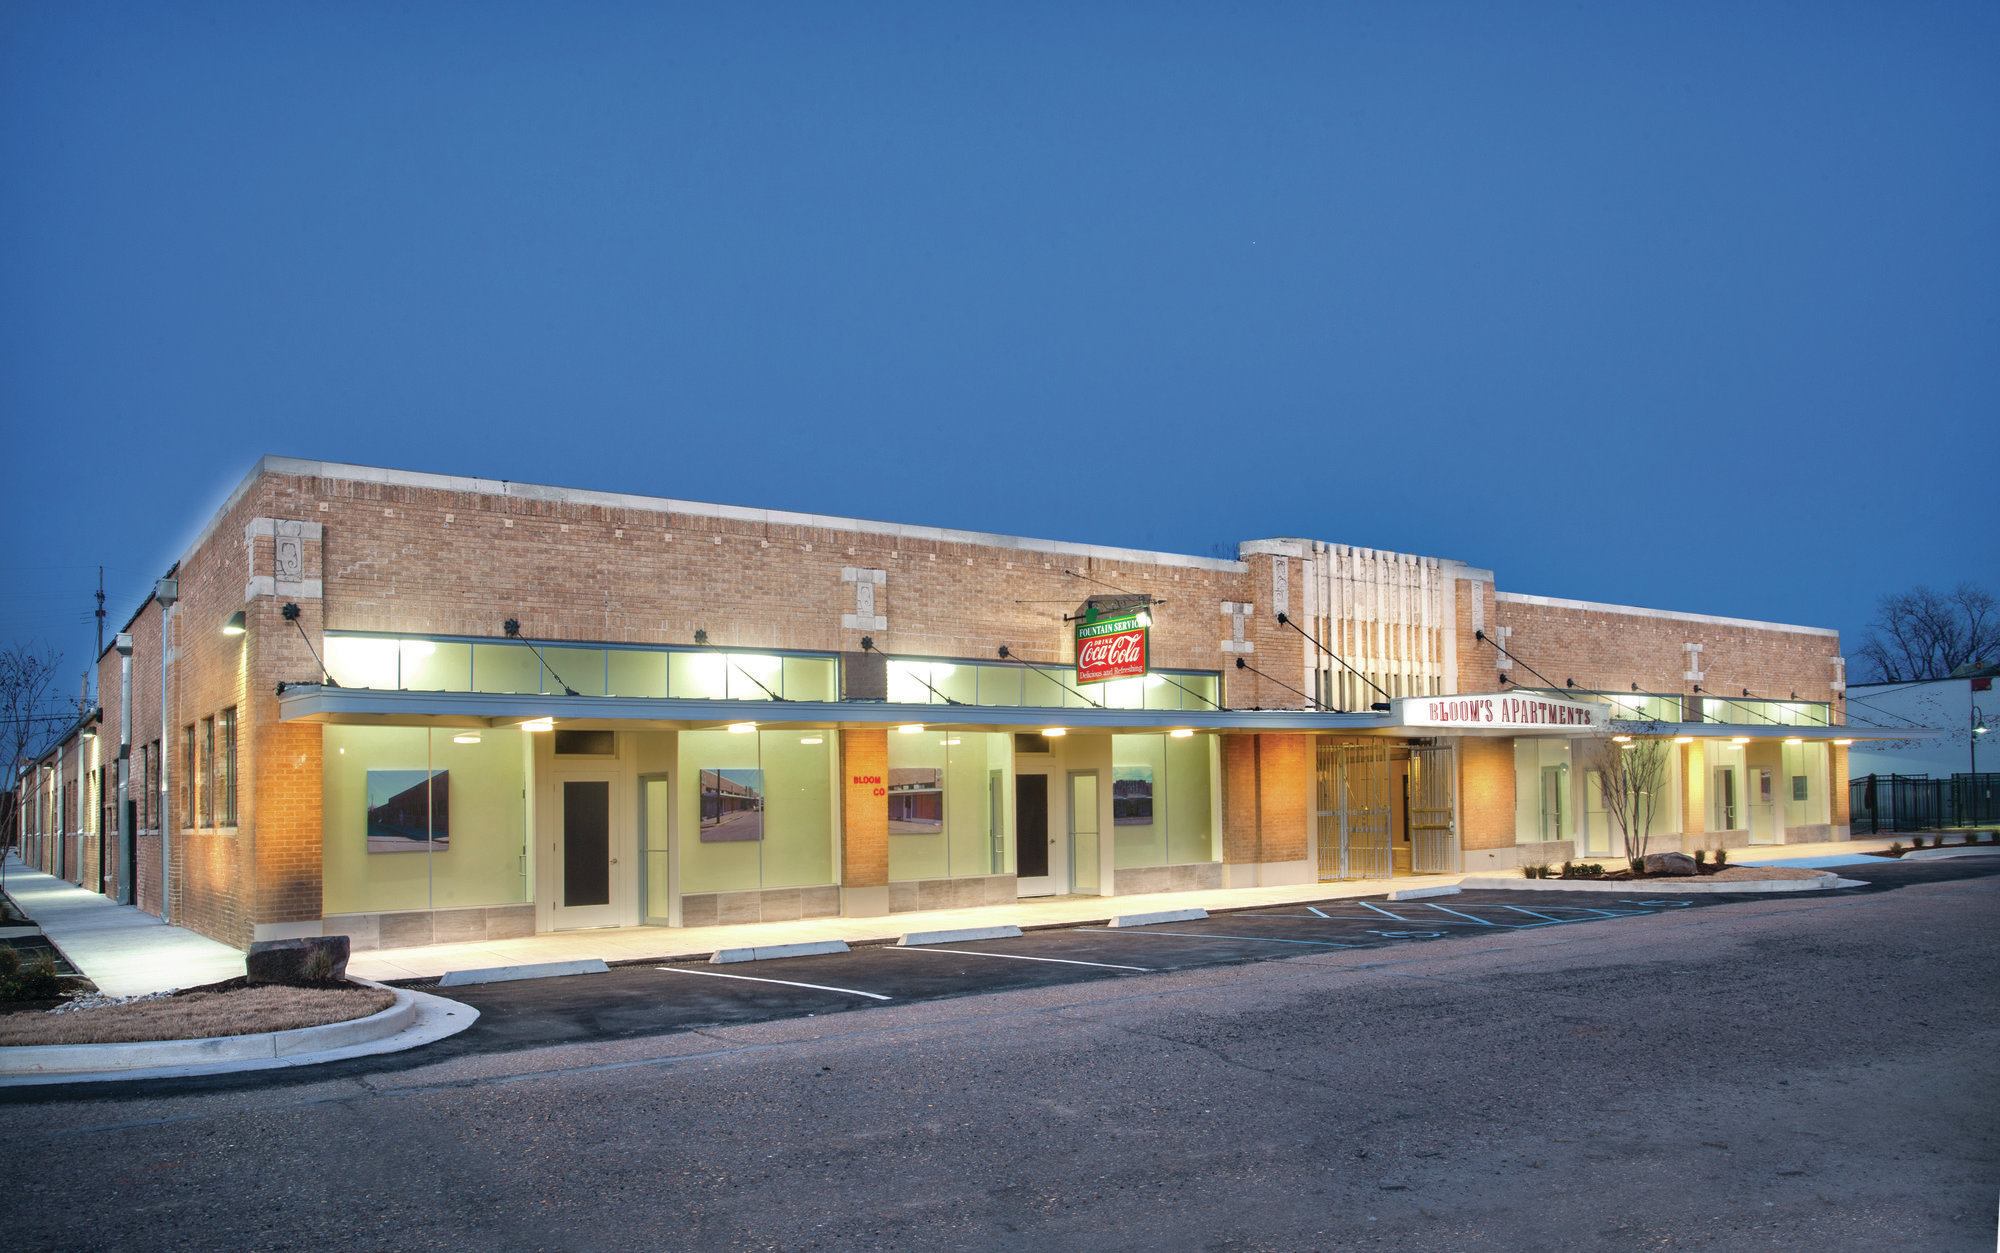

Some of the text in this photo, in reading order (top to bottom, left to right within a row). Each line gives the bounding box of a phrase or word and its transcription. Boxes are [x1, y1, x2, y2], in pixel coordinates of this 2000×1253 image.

[1079, 619, 1144, 638] FOUNTAIN SERVIC
[1094, 638, 1113, 646] DRINK
[1079, 633, 1142, 669] Coca-Cola
[1080, 670, 1102, 679] Delicious
[1103, 668, 1113, 676] and
[1429, 698, 1591, 725] BLOOM'S APARTMENTS
[853, 776, 881, 784] BLOOM
[873, 788, 885, 796] CO
